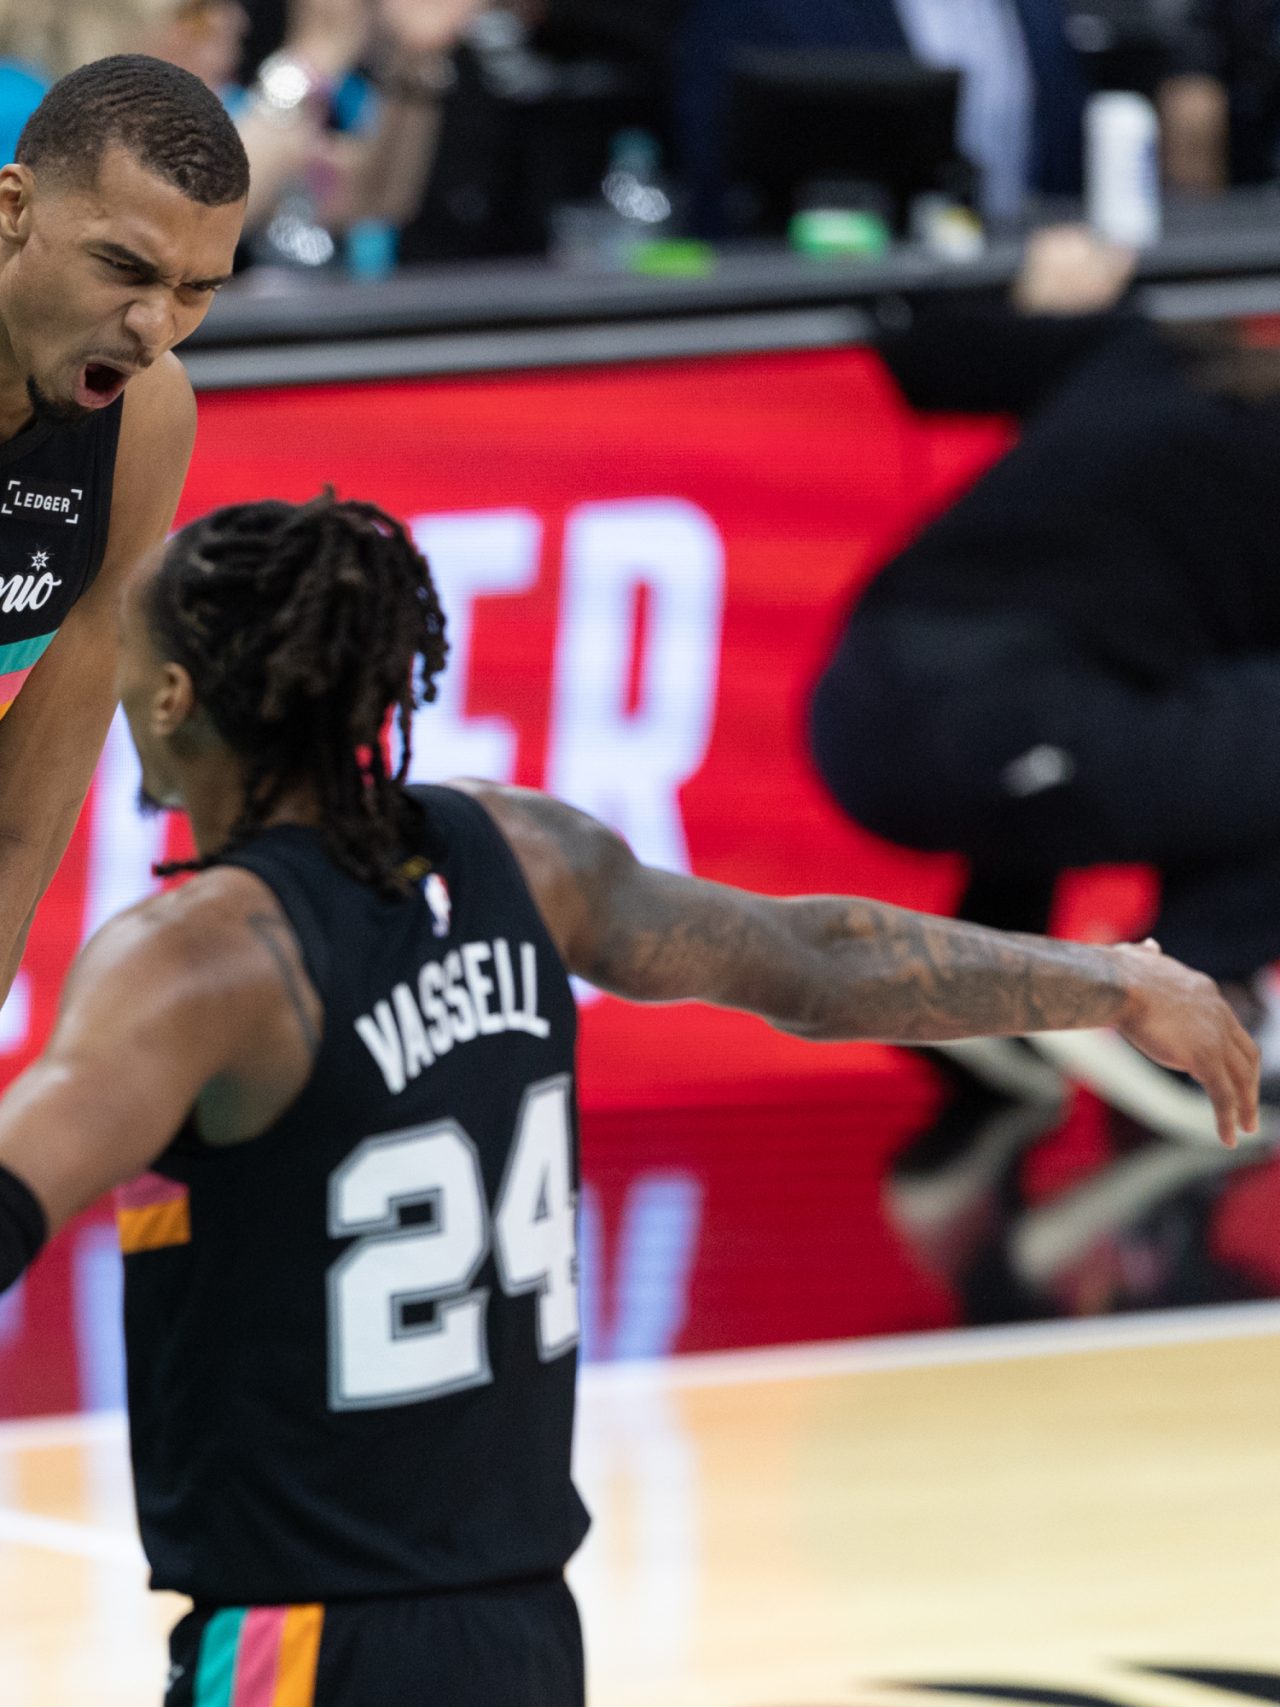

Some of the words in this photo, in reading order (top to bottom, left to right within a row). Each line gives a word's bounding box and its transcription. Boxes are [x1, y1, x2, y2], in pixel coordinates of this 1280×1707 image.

[14, 491, 71, 513] LEDGER
[354, 938, 550, 1094] VASSELL
[326, 1072, 580, 1413] 24
